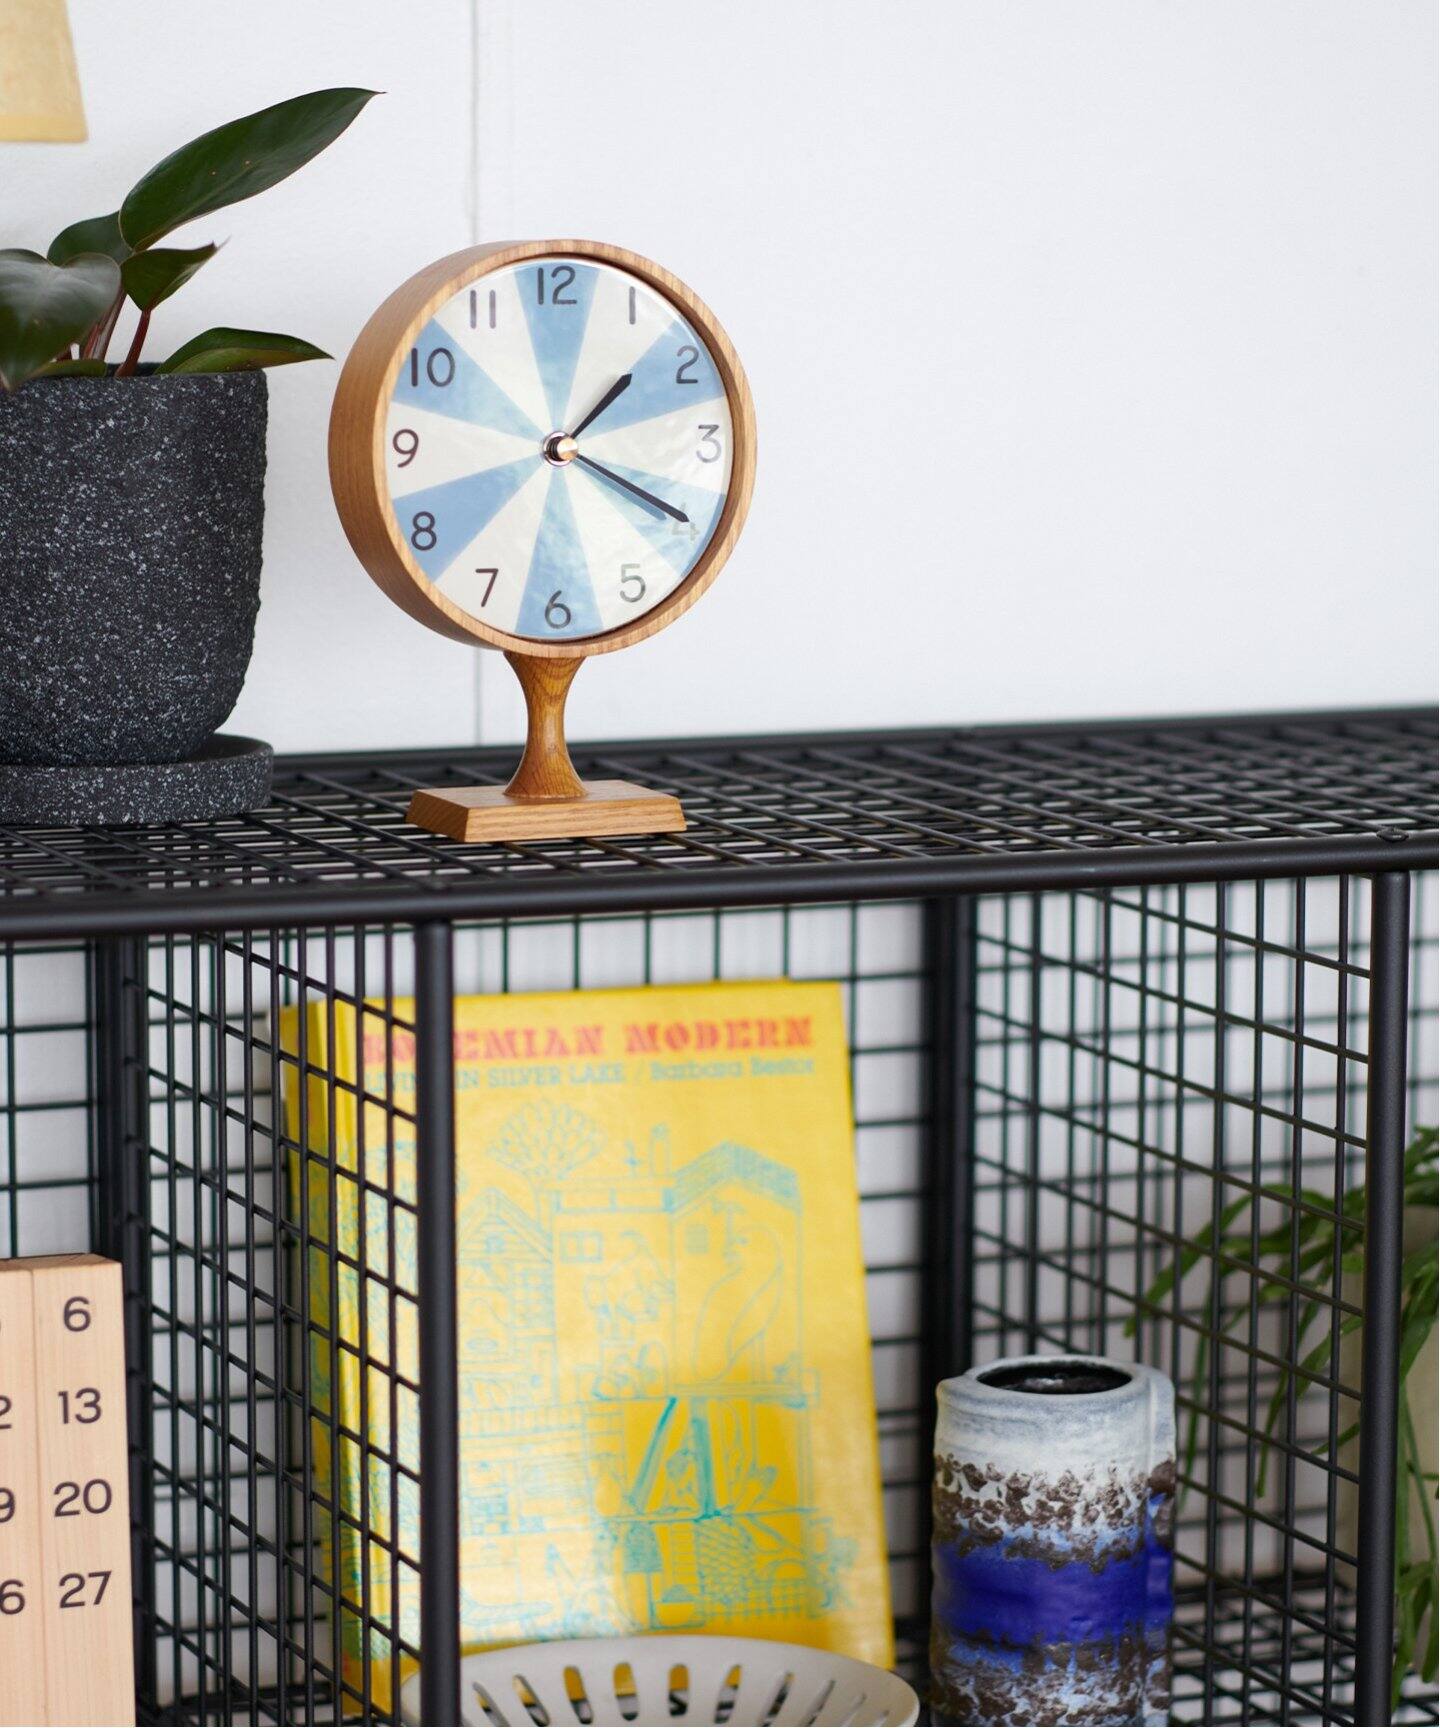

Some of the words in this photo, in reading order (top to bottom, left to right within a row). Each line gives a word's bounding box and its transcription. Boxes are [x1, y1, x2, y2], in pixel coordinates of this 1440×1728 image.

[537, 265, 577, 305] 12
[469, 289, 497, 329] 11
[627, 286, 637, 325] 1
[410, 347, 456, 387] 10
[675, 345, 700, 385] 2
[392, 428, 419, 468] 9
[695, 424, 722, 463] 3
[410, 511, 437, 551] 8
[475, 568, 499, 607] 7
[619, 563, 646, 602] 5
[544, 590, 571, 629] 6
[364, 1026, 603, 1065] BOEMIAN
[625, 1017, 811, 1053] MODERN
[487, 1064, 560, 1088] SILVER
[568, 1060, 625, 1084] LAKE
[651, 1058, 742, 1083] Barbara
[63, 1296, 92, 1333] 6
[57, 1387, 102, 1425] 13
[53, 1479, 112, 1517] 20
[58, 1571, 112, 1609] 27
